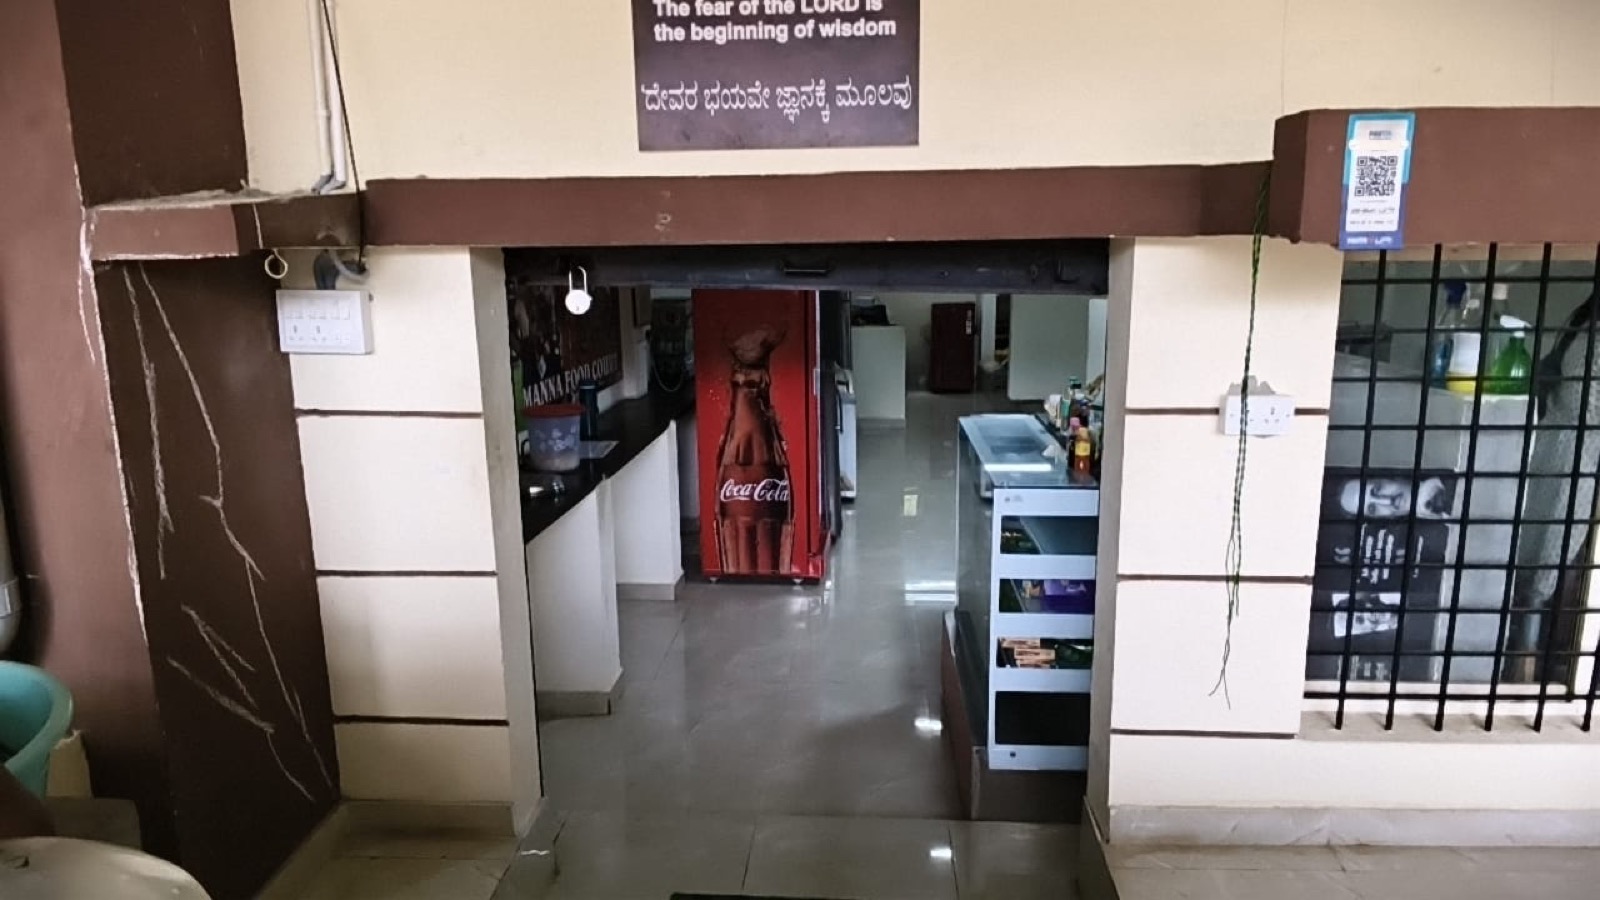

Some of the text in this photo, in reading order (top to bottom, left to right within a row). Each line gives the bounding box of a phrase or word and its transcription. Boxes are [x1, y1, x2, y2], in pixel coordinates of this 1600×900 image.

[653, 0, 884, 16] The fear of the LORD is
[654, 17, 897, 45] the beginning of wisdom
[640, 80, 698, 111] ದೇವರ
[703, 79, 771, 117] ಭಯವೇ
[835, 75, 912, 110] ಮೂಲವು
[523, 373, 565, 407] MANNA
[564, 363, 591, 395] FOOD
